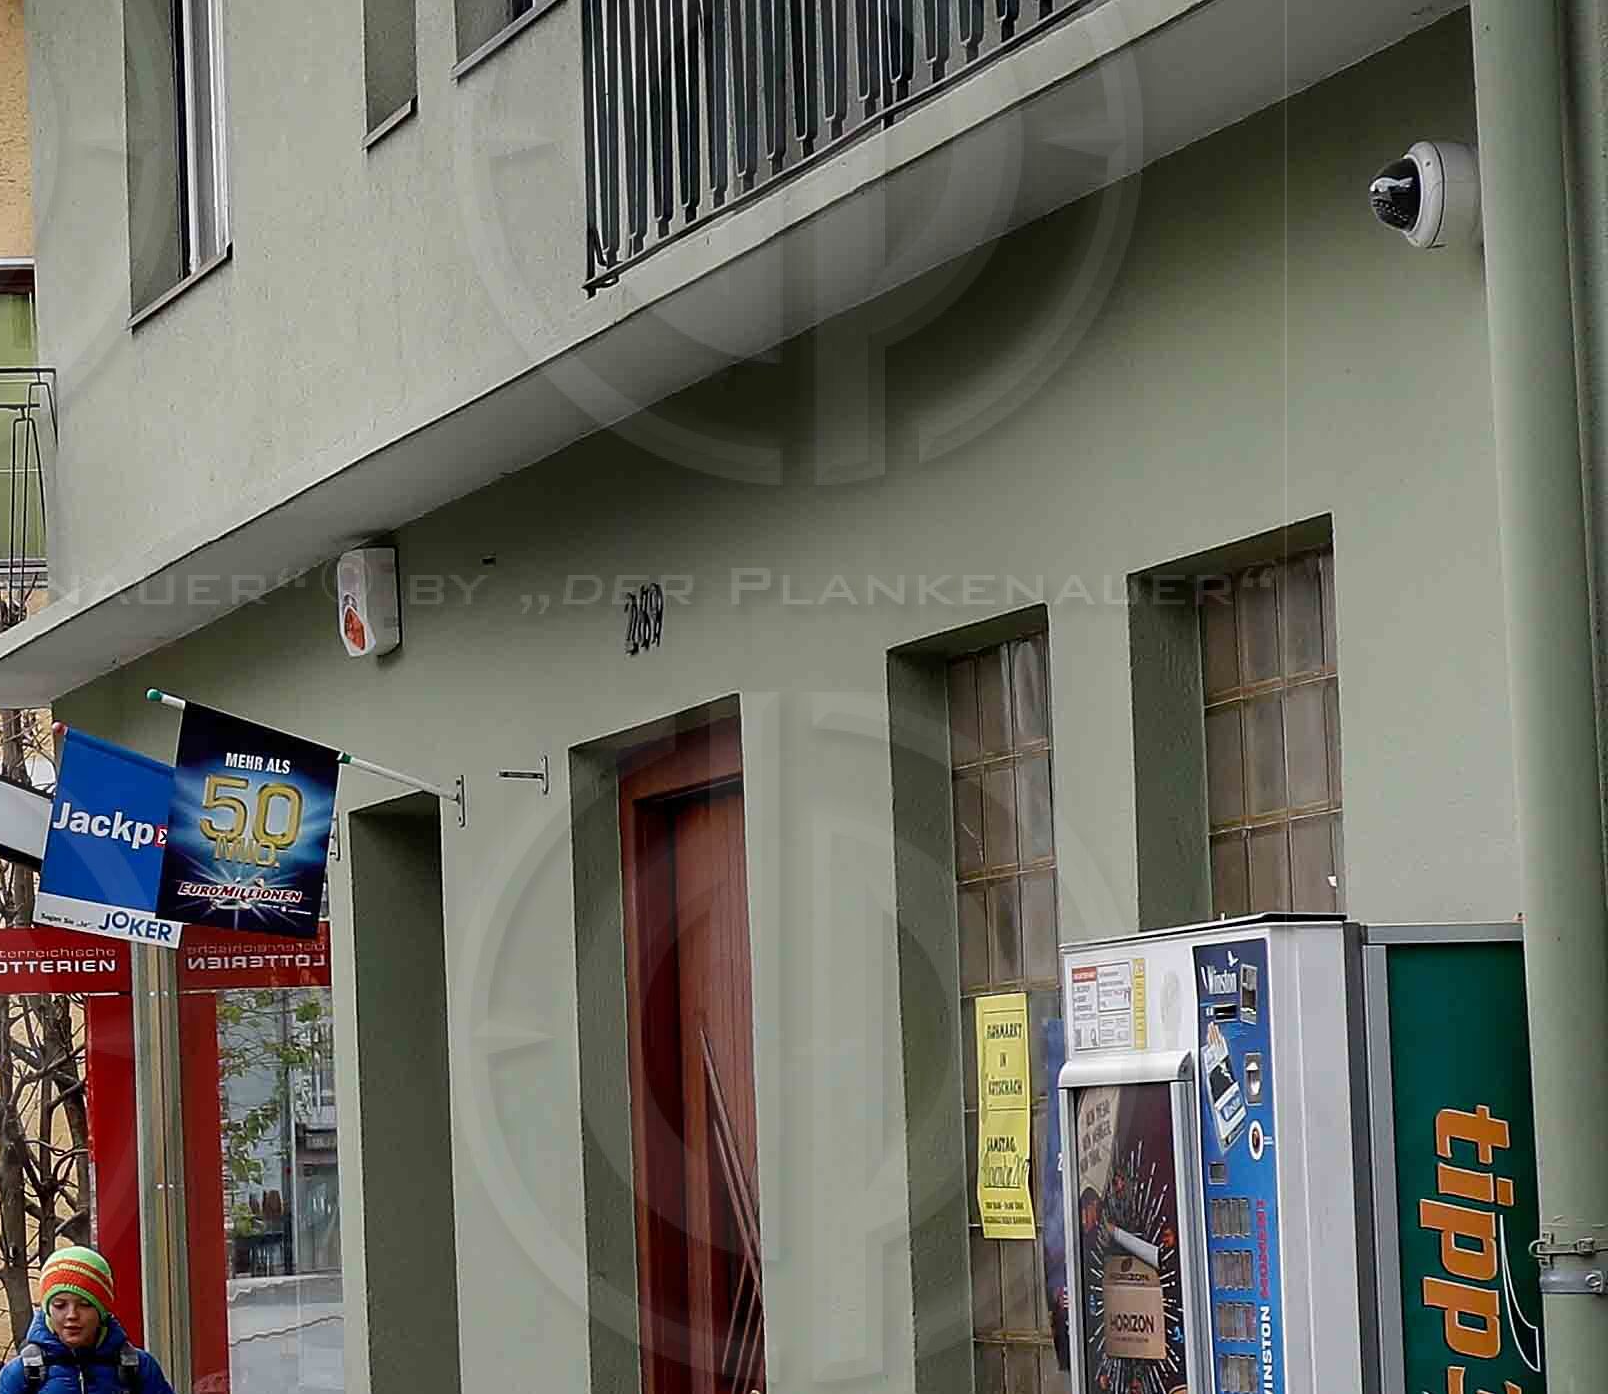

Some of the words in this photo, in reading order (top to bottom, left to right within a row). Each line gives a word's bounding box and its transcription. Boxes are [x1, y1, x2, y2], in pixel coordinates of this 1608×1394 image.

[225, 752, 262, 771] MEHR
[264, 757, 291, 775] ALS
[199, 774, 304, 850] 50
[98, 911, 172, 942] JOKER
